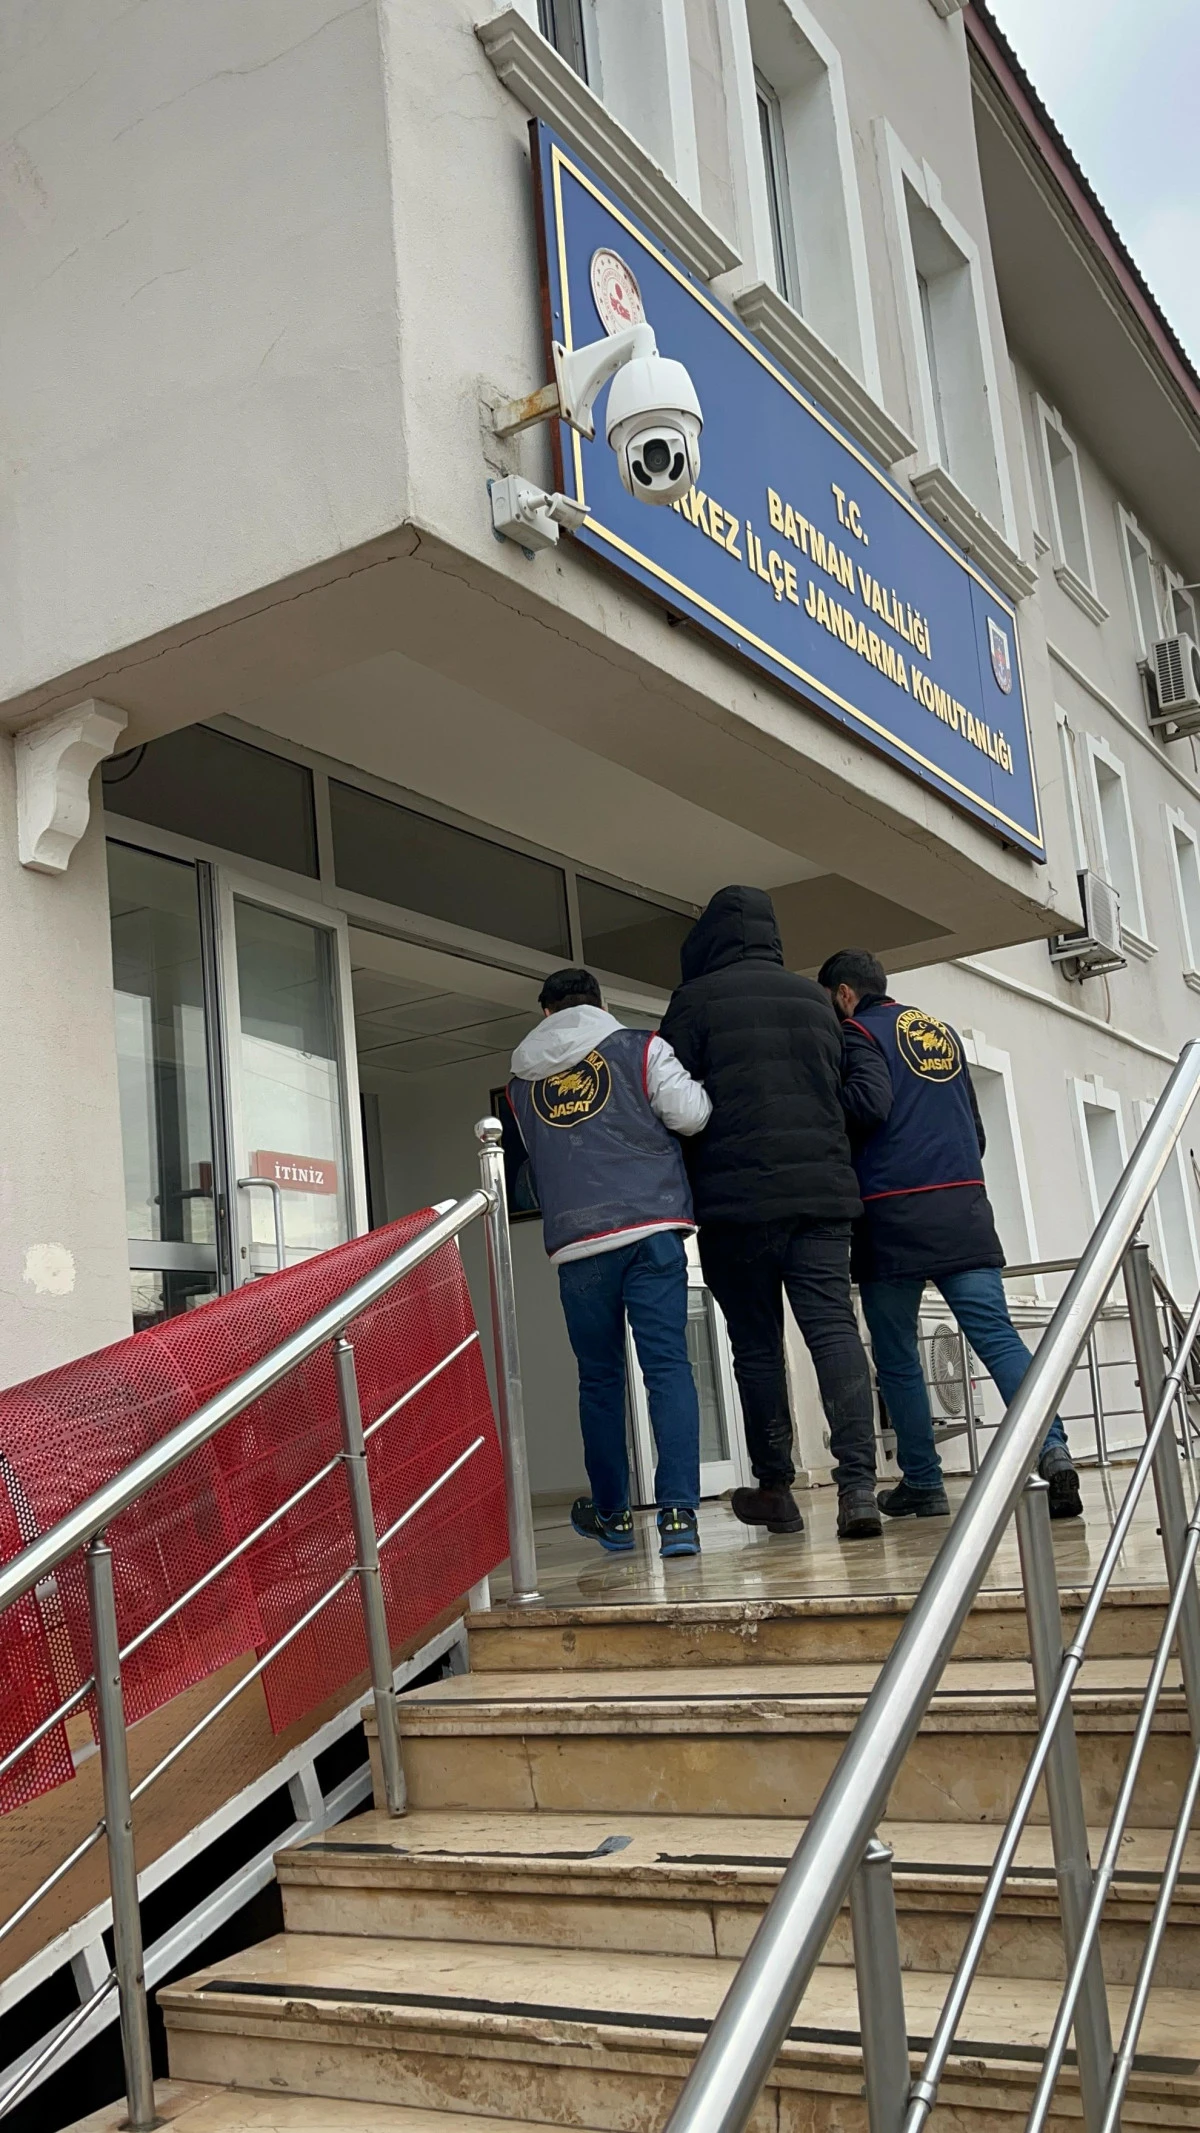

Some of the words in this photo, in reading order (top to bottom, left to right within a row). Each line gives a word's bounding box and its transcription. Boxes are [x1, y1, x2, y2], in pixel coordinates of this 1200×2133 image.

[831, 483, 869, 546] T.C.
[767, 486, 856, 595] BATMAN
[857, 565, 932, 661] VALİLİĞİ
[669, 484, 742, 561] KEZ
[745, 519, 800, 606] İLÇE
[804, 579, 910, 693] JANDARMA
[911, 664, 1014, 775] KOMUTANLIĞI
[920, 1058, 954, 1072] JASAT
[549, 1100, 592, 1119] JASAT
[274, 1160, 324, 1185] İTİNİZ
